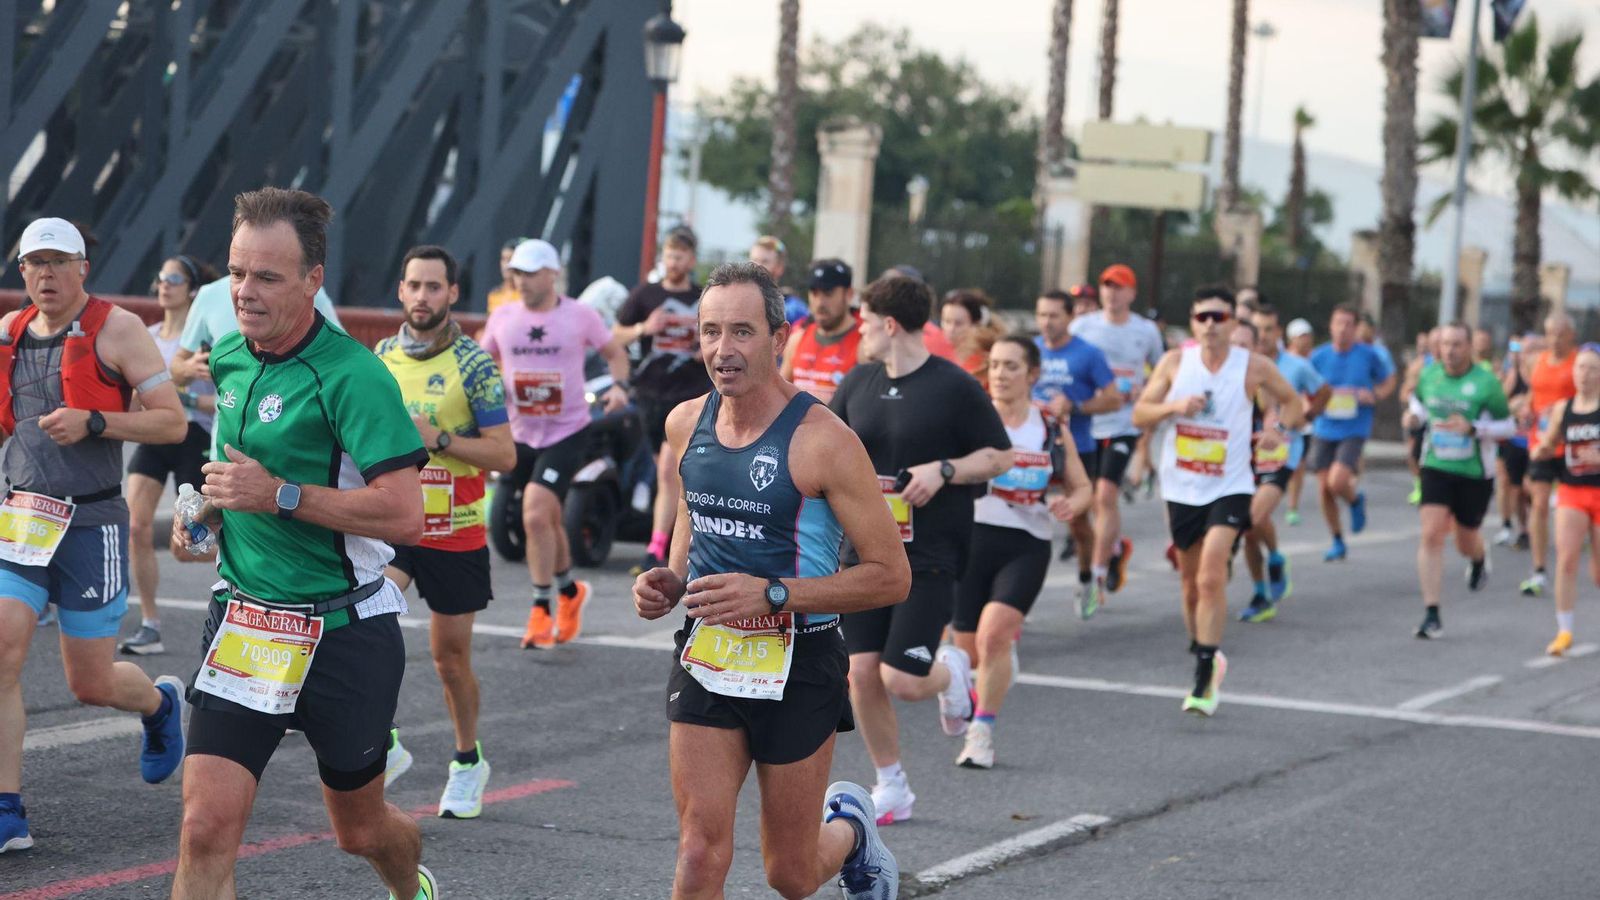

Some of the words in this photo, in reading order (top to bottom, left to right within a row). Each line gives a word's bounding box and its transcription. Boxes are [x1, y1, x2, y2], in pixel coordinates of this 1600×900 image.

[420, 470, 448, 481] ERALI
[717, 497, 725, 507] A
[727, 497, 772, 515] CORRER
[248, 611, 313, 635] GENERALI
[726, 615, 784, 629] NERALI
[713, 635, 769, 660] 11415
